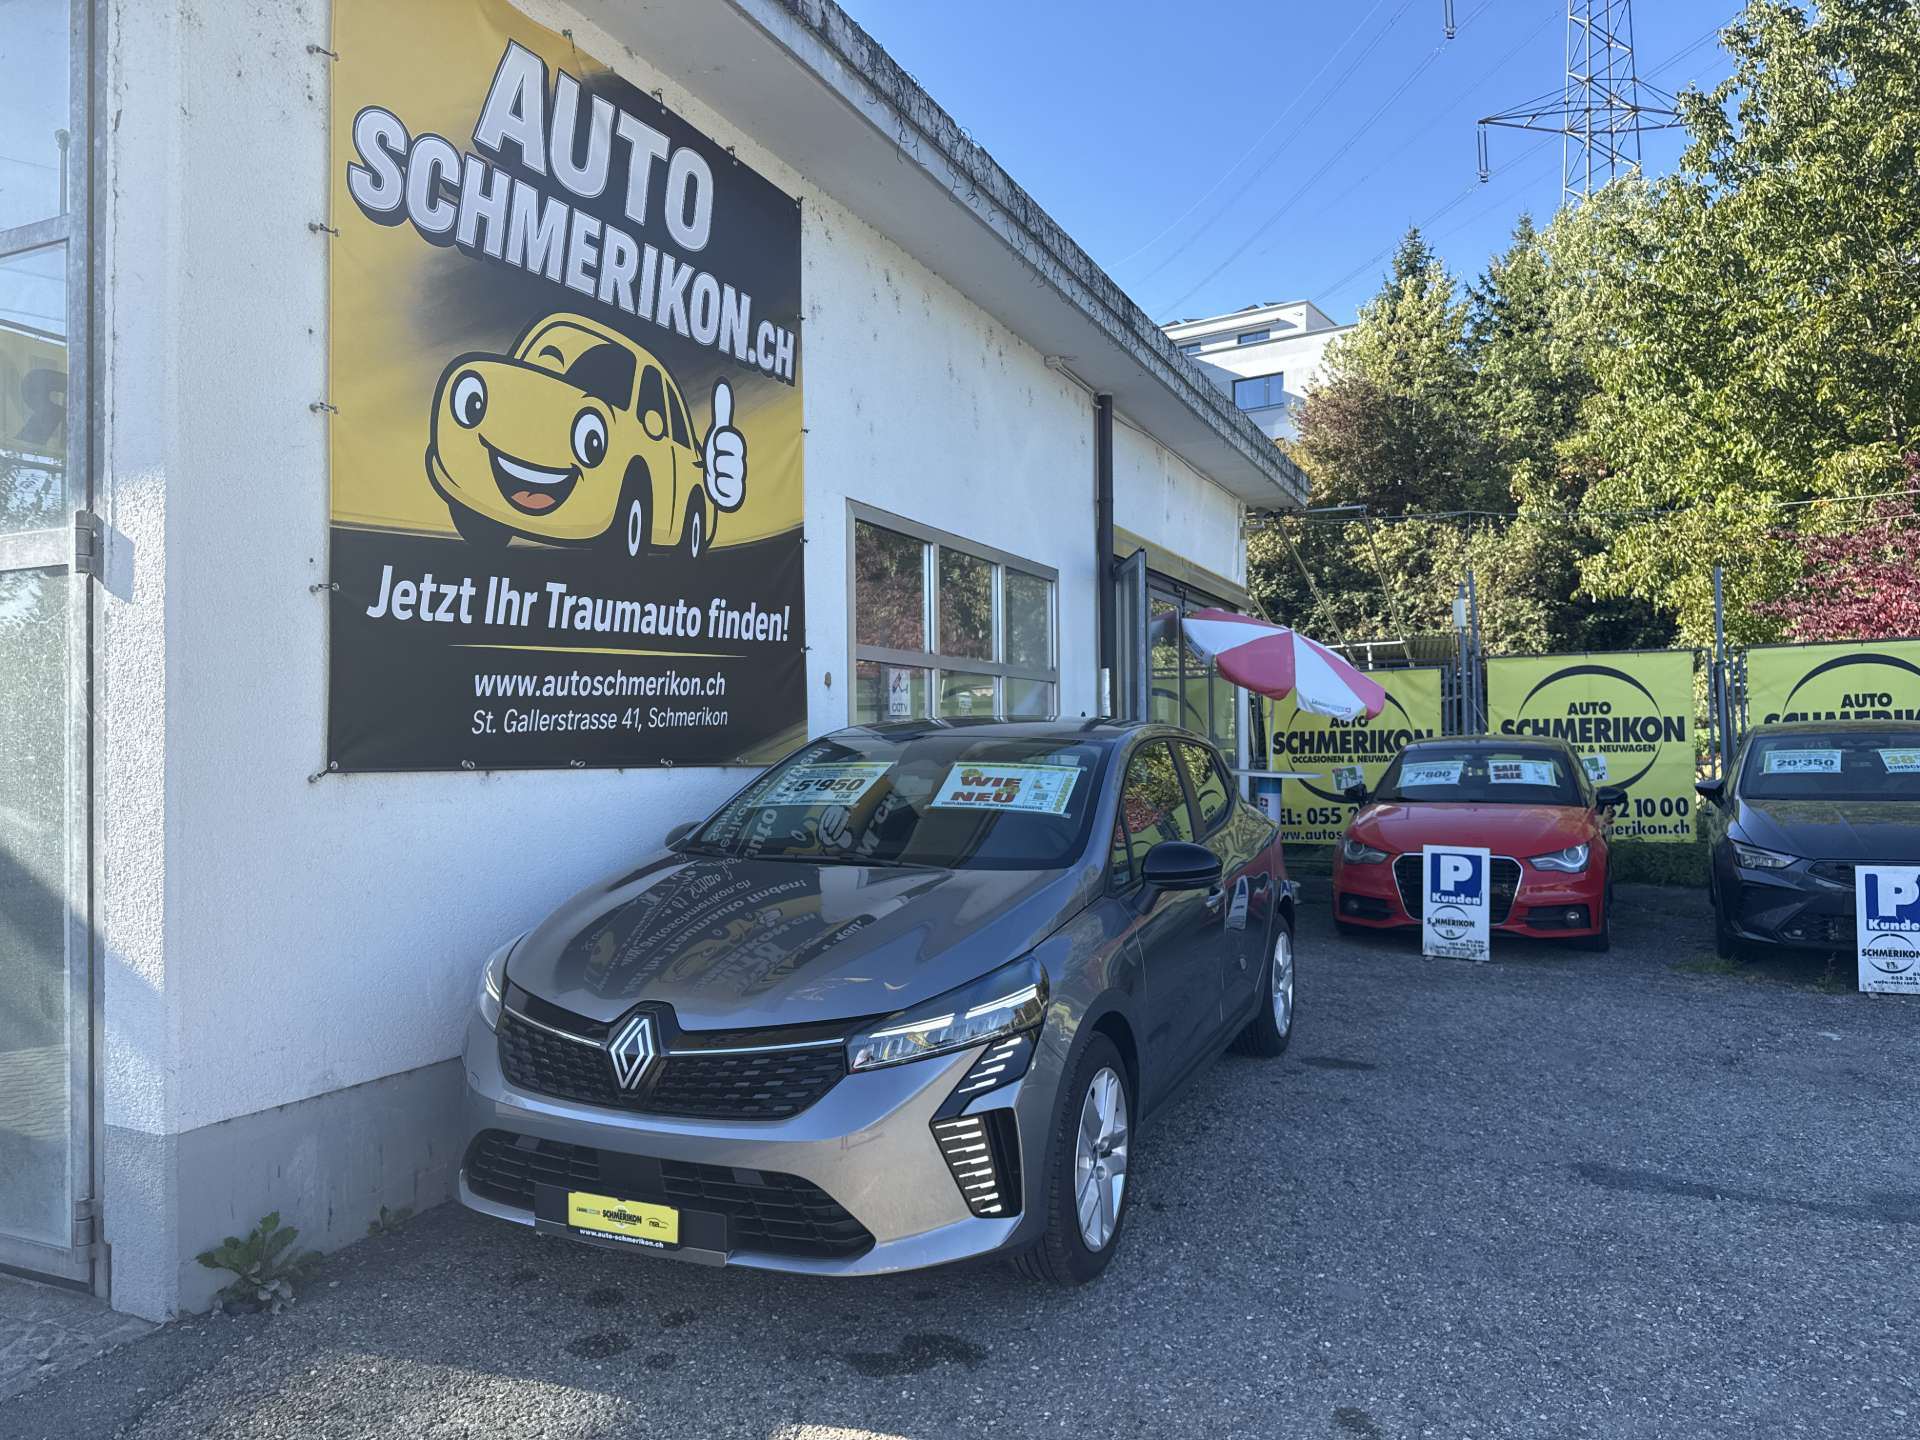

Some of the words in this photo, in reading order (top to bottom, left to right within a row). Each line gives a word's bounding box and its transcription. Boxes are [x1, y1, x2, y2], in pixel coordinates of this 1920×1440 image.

[473, 40, 714, 252] AUTO
[347, 107, 795, 381] SCHMERIKON.CH
[366, 564, 476, 625] Jetzt
[483, 576, 539, 628] Ihr
[544, 582, 702, 638] Traumauto
[707, 600, 791, 642] finden!
[474, 669, 726, 698] www.autoschmerikon.ch
[1567, 701, 1612, 716] AUTO
[1841, 692, 1893, 708] AUTO
[471, 708, 496, 735] St.
[503, 708, 618, 732] Gallerstrasse
[621, 708, 643, 734] 41,
[648, 706, 728, 729] Schmerikon
[1501, 715, 1686, 743] SCHMERIKON
[1599, 743, 1656, 753] NEUWAGEN
[1291, 755, 1345, 764] OCCASIONEN
[960, 776, 1022, 788] WIE
[950, 791, 1017, 803] NEU
[1307, 806, 1342, 825] 055
[1440, 854, 1473, 892] P
[1431, 892, 1481, 906] Kunden
[1877, 871, 1920, 917] P
[602, 1209, 642, 1224] SCHMERIKON
